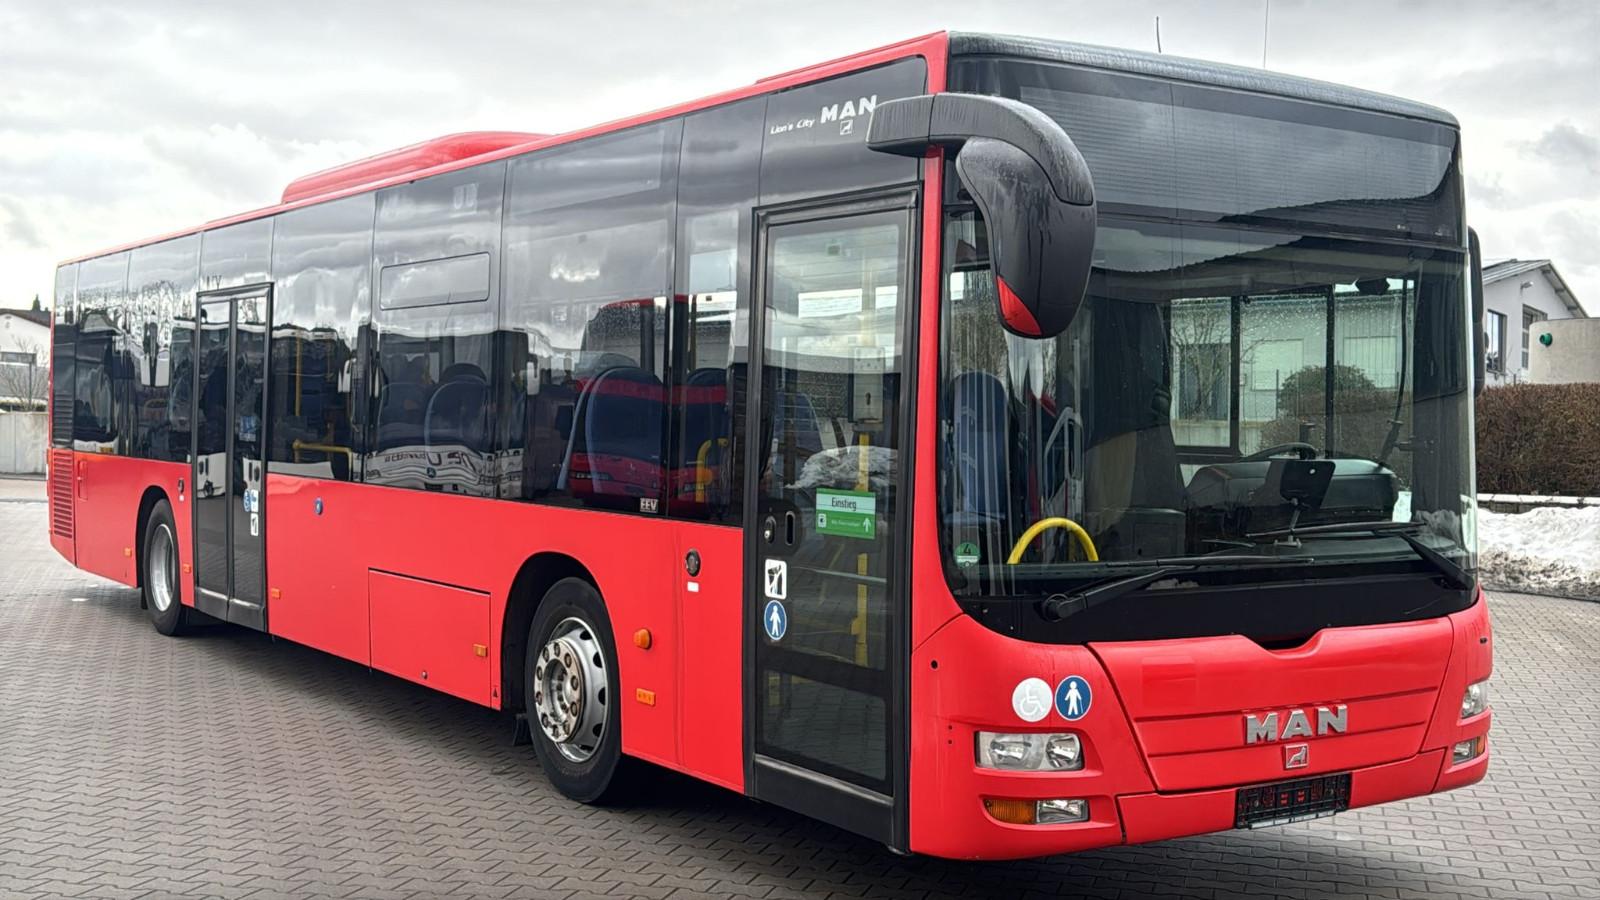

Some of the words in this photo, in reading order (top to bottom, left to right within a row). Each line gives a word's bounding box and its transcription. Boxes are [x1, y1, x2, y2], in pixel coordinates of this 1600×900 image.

[770, 122, 794, 134] Lion's
[796, 118, 815, 129] City
[820, 95, 877, 124] MAN
[639, 498, 658, 513] EEV
[831, 497, 857, 511] Einstieg
[1244, 703, 1348, 744] MAN
